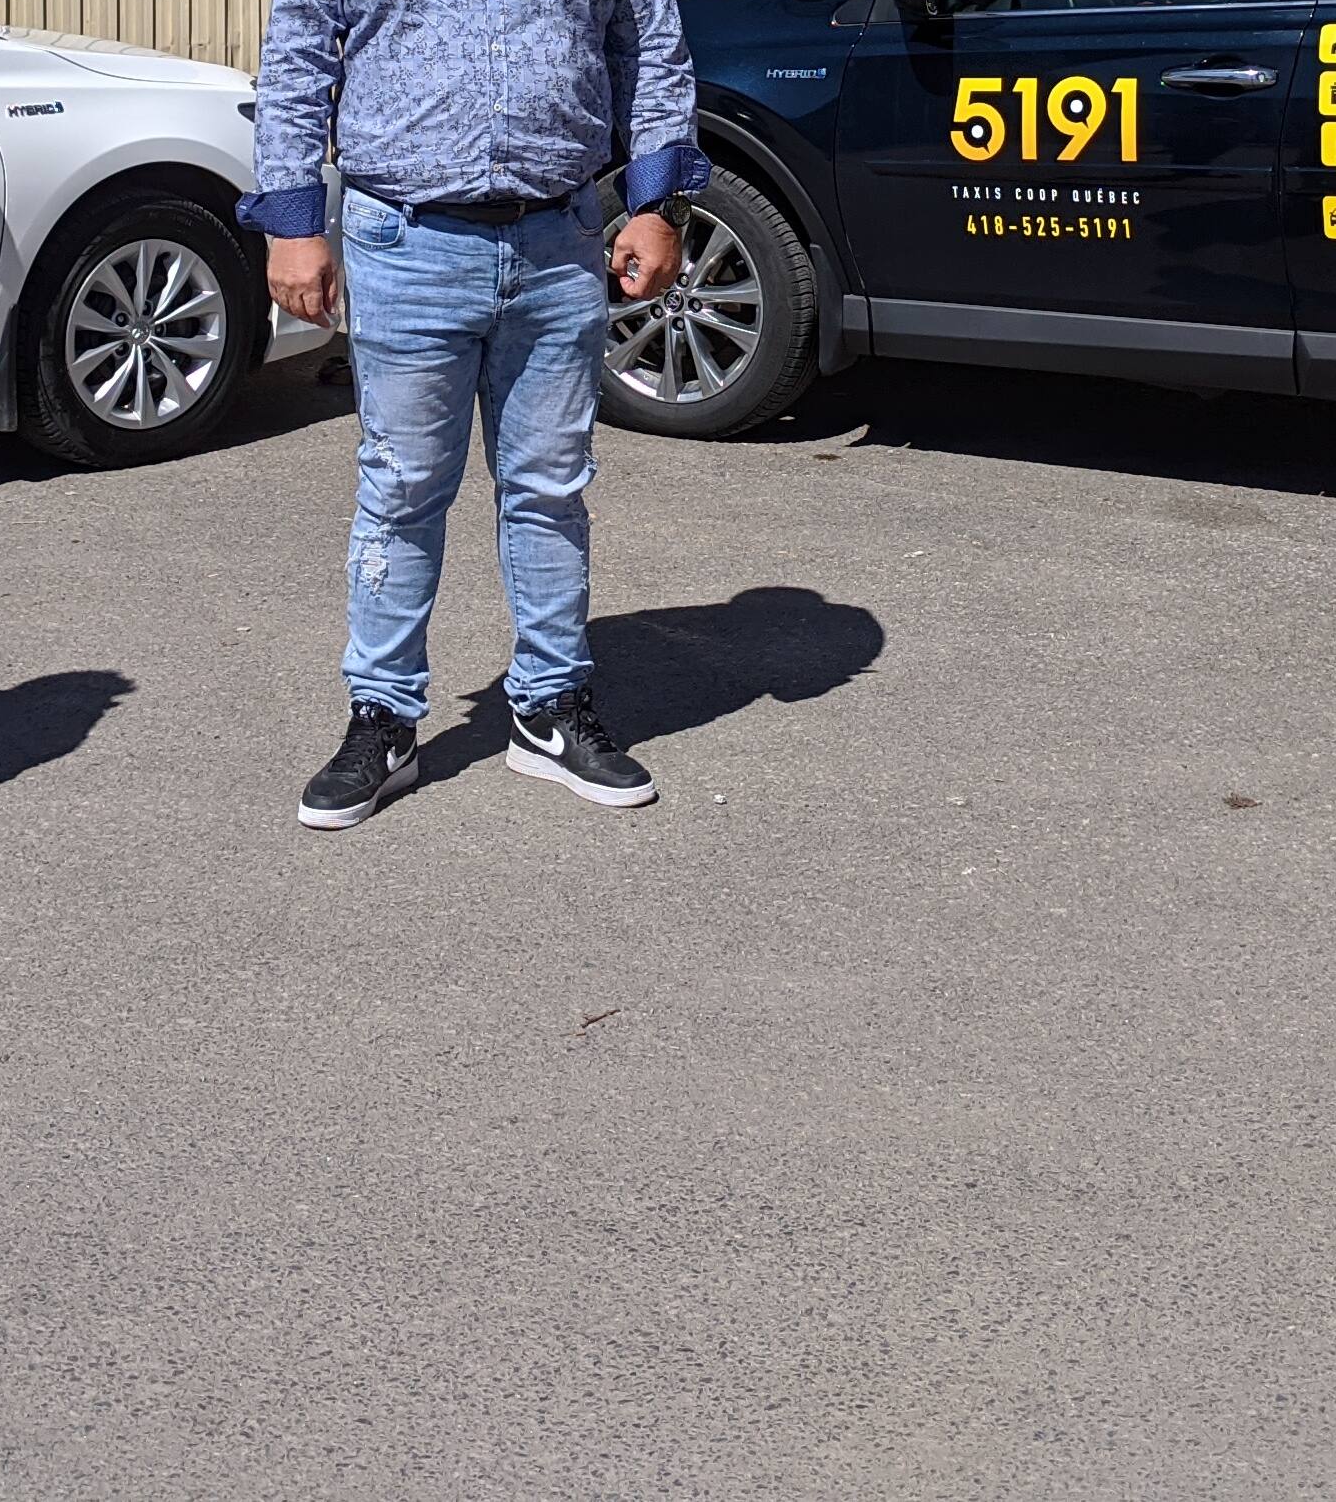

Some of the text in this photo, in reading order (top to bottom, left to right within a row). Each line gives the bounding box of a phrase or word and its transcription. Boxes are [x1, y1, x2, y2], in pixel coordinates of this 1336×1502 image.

[766, 68, 817, 78] HYBRID
[950, 76, 1137, 162] 5191
[952, 185, 1140, 205] TAXIS COOP QUÉBEC
[967, 214, 1131, 239] 418-525-5191
